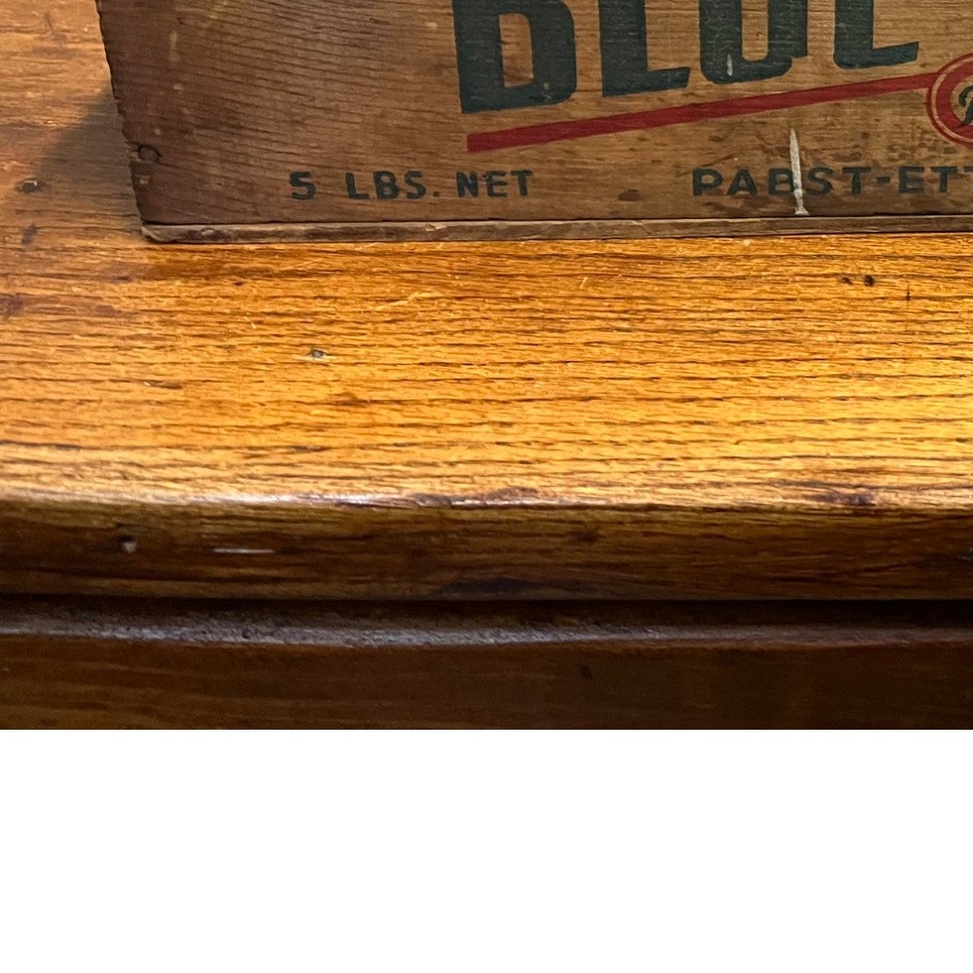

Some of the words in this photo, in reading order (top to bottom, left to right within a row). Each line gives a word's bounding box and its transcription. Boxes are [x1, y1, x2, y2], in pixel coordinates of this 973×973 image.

[289, 171, 316, 200] 5
[345, 170, 440, 200] LBS.
[456, 169, 533, 198] NET
